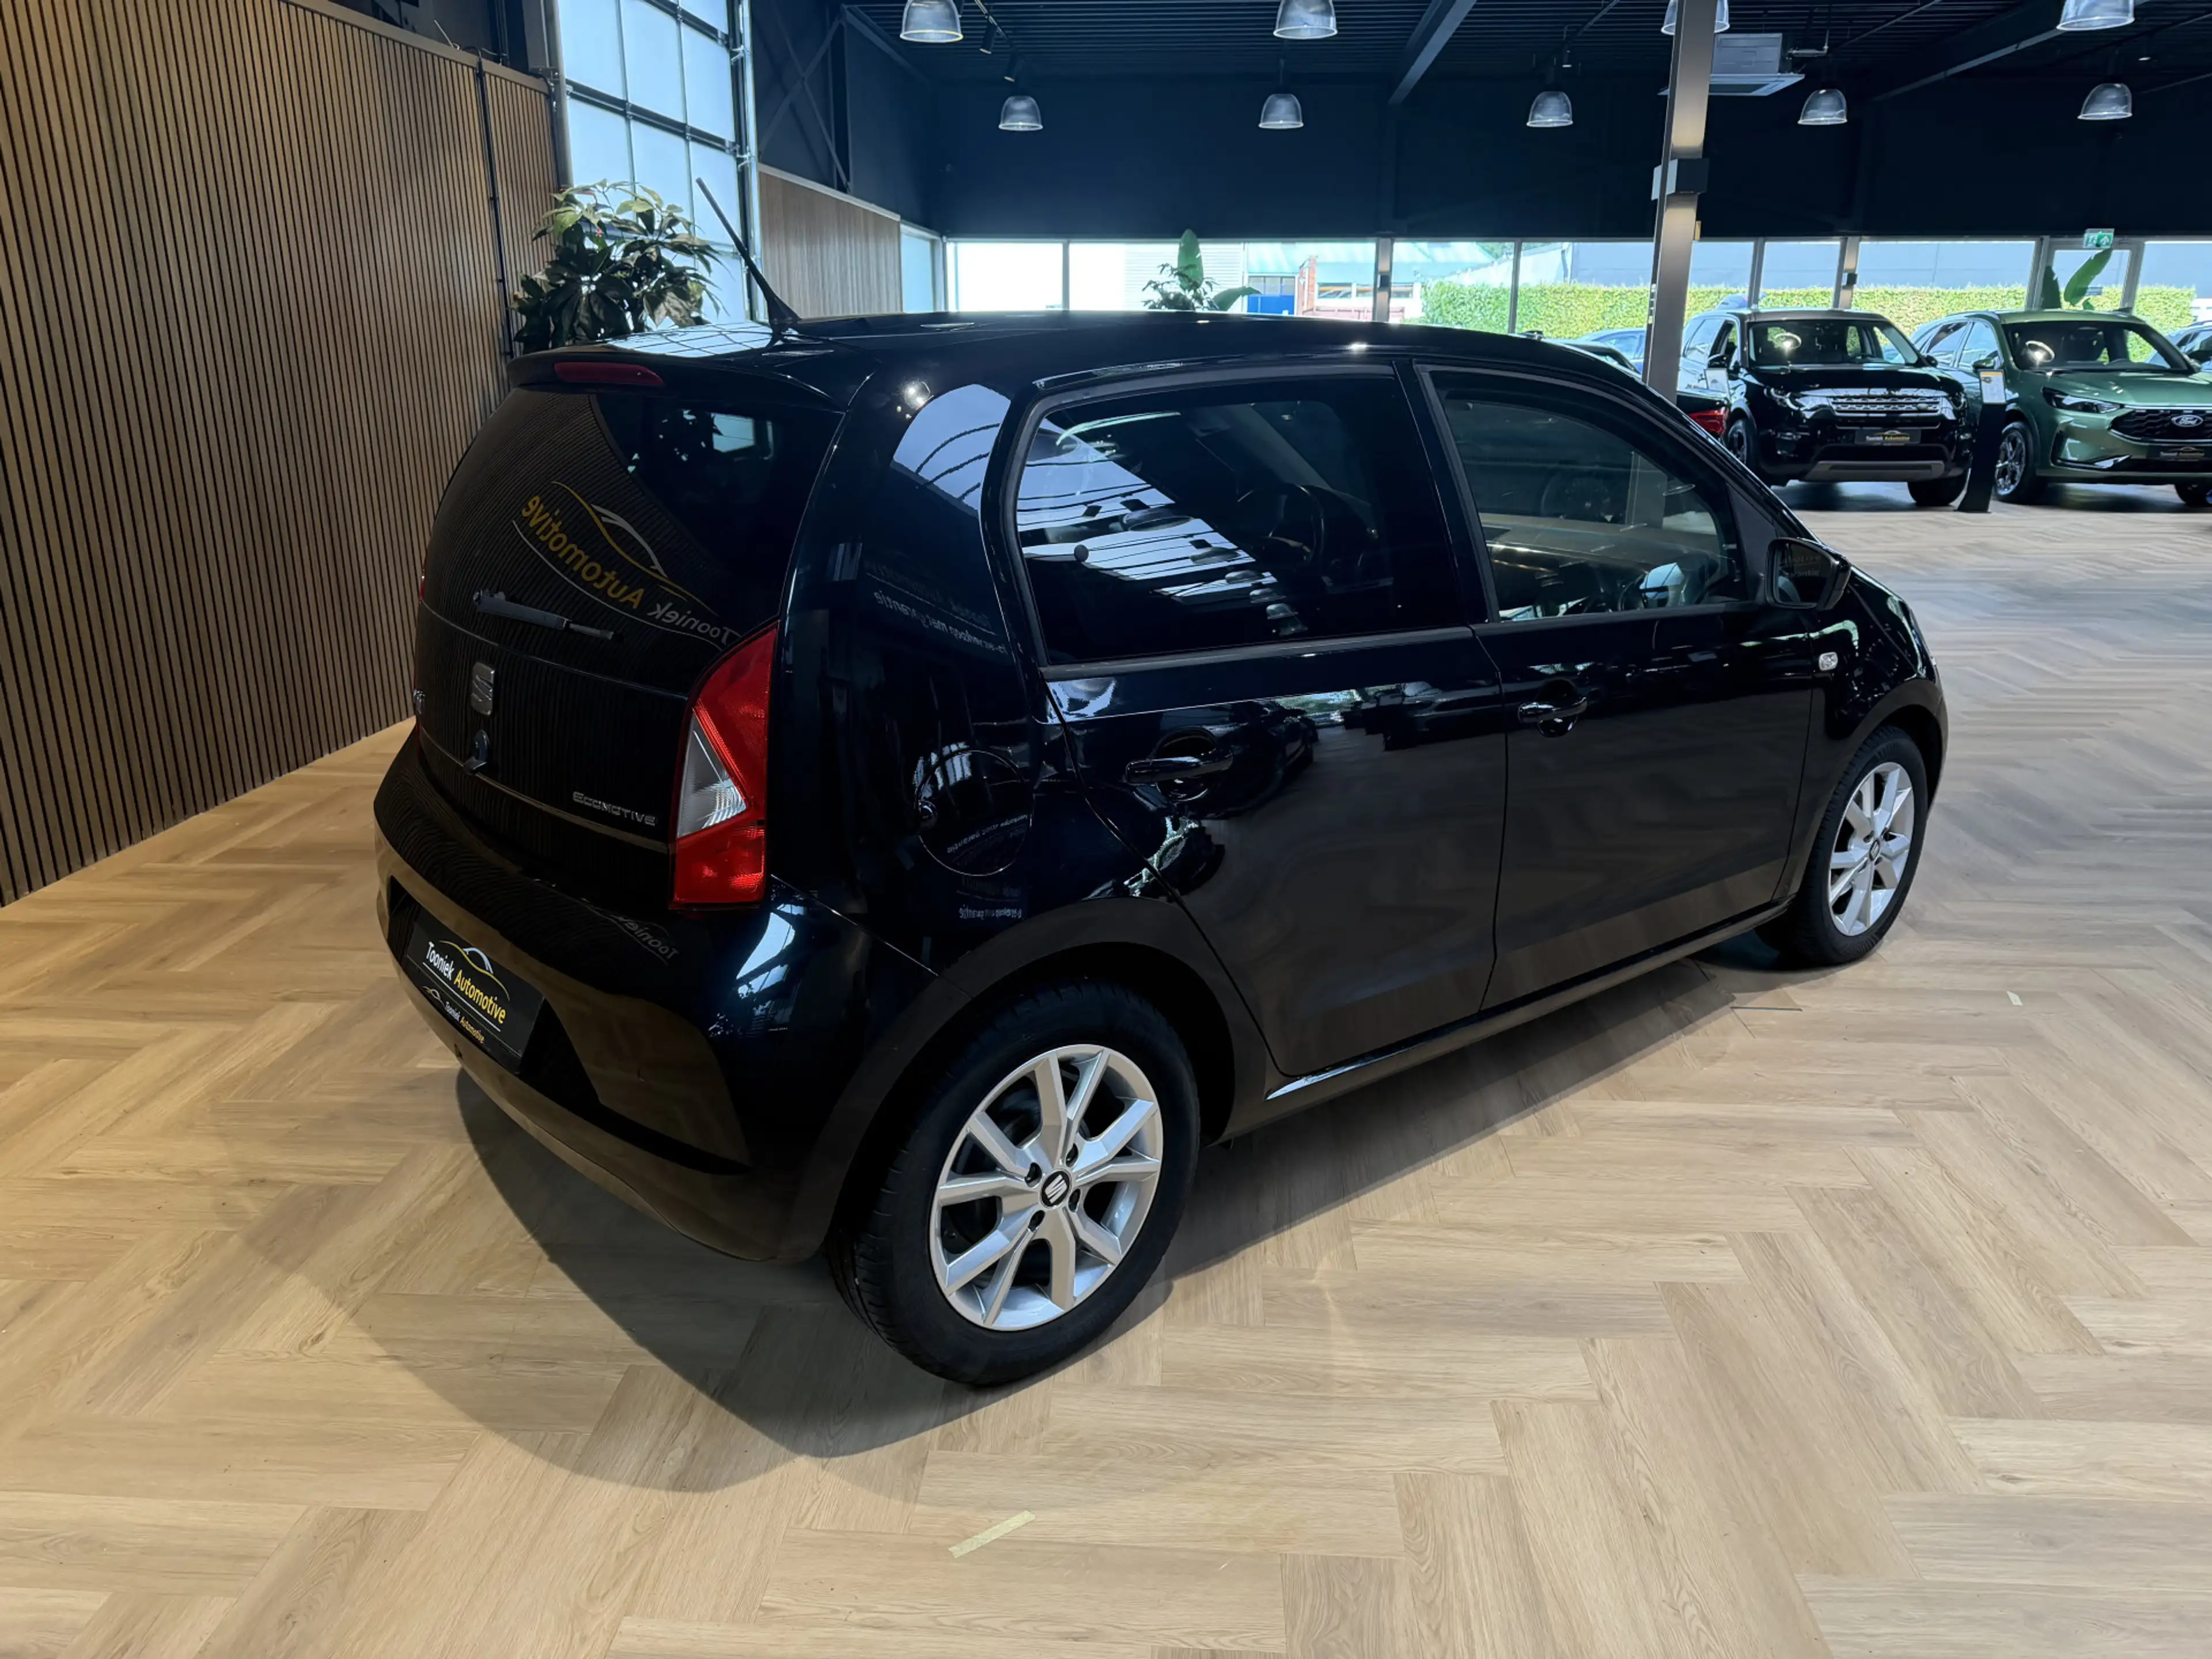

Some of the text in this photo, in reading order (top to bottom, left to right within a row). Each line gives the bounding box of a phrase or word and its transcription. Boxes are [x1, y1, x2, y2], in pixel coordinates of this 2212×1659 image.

[426, 941, 507, 1024] Tooniek Automotive
[444, 1001, 485, 1043] Tooniek Automotive
